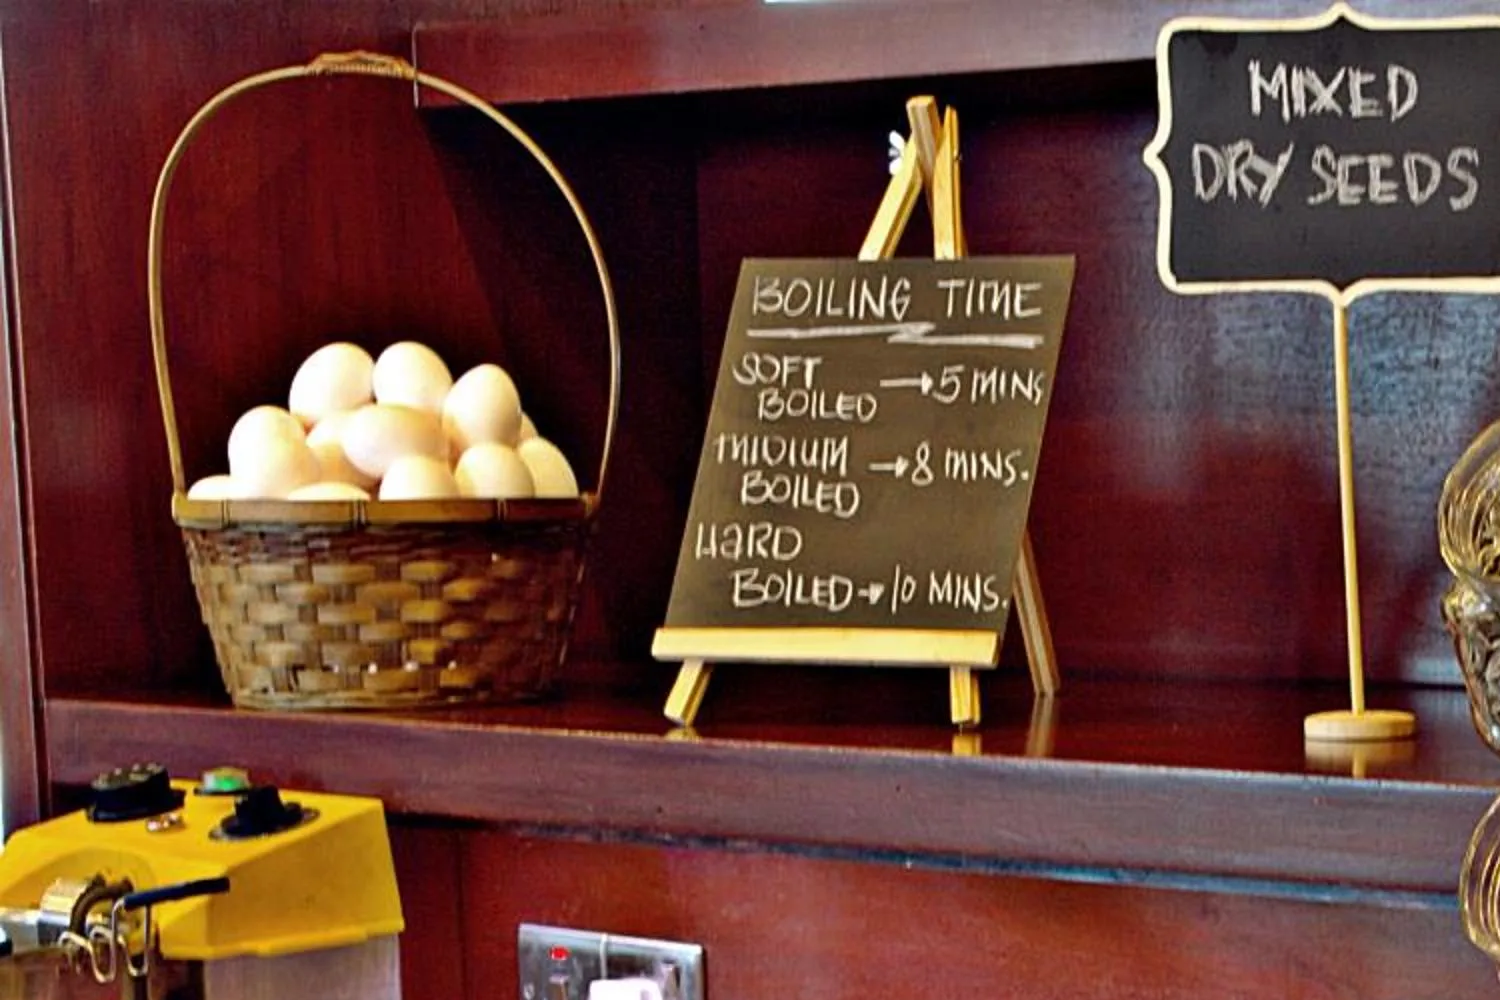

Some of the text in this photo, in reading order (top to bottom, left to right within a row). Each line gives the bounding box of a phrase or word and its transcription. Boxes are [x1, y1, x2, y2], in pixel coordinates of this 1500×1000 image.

[1249, 60, 1418, 122] MIXED
[1192, 139, 1479, 210] DRY SEEDS
[753, 276, 1042, 321] BOILING TIME
[732, 352, 822, 389] SOFT
[932, 364, 1045, 406] 5 MINS
[758, 389, 876, 422] BOILED
[911, 441, 1029, 487] 8 MINS.
[741, 470, 860, 518] BOILED
[733, 568, 852, 613] BOILED
[890, 565, 914, 615] 10
